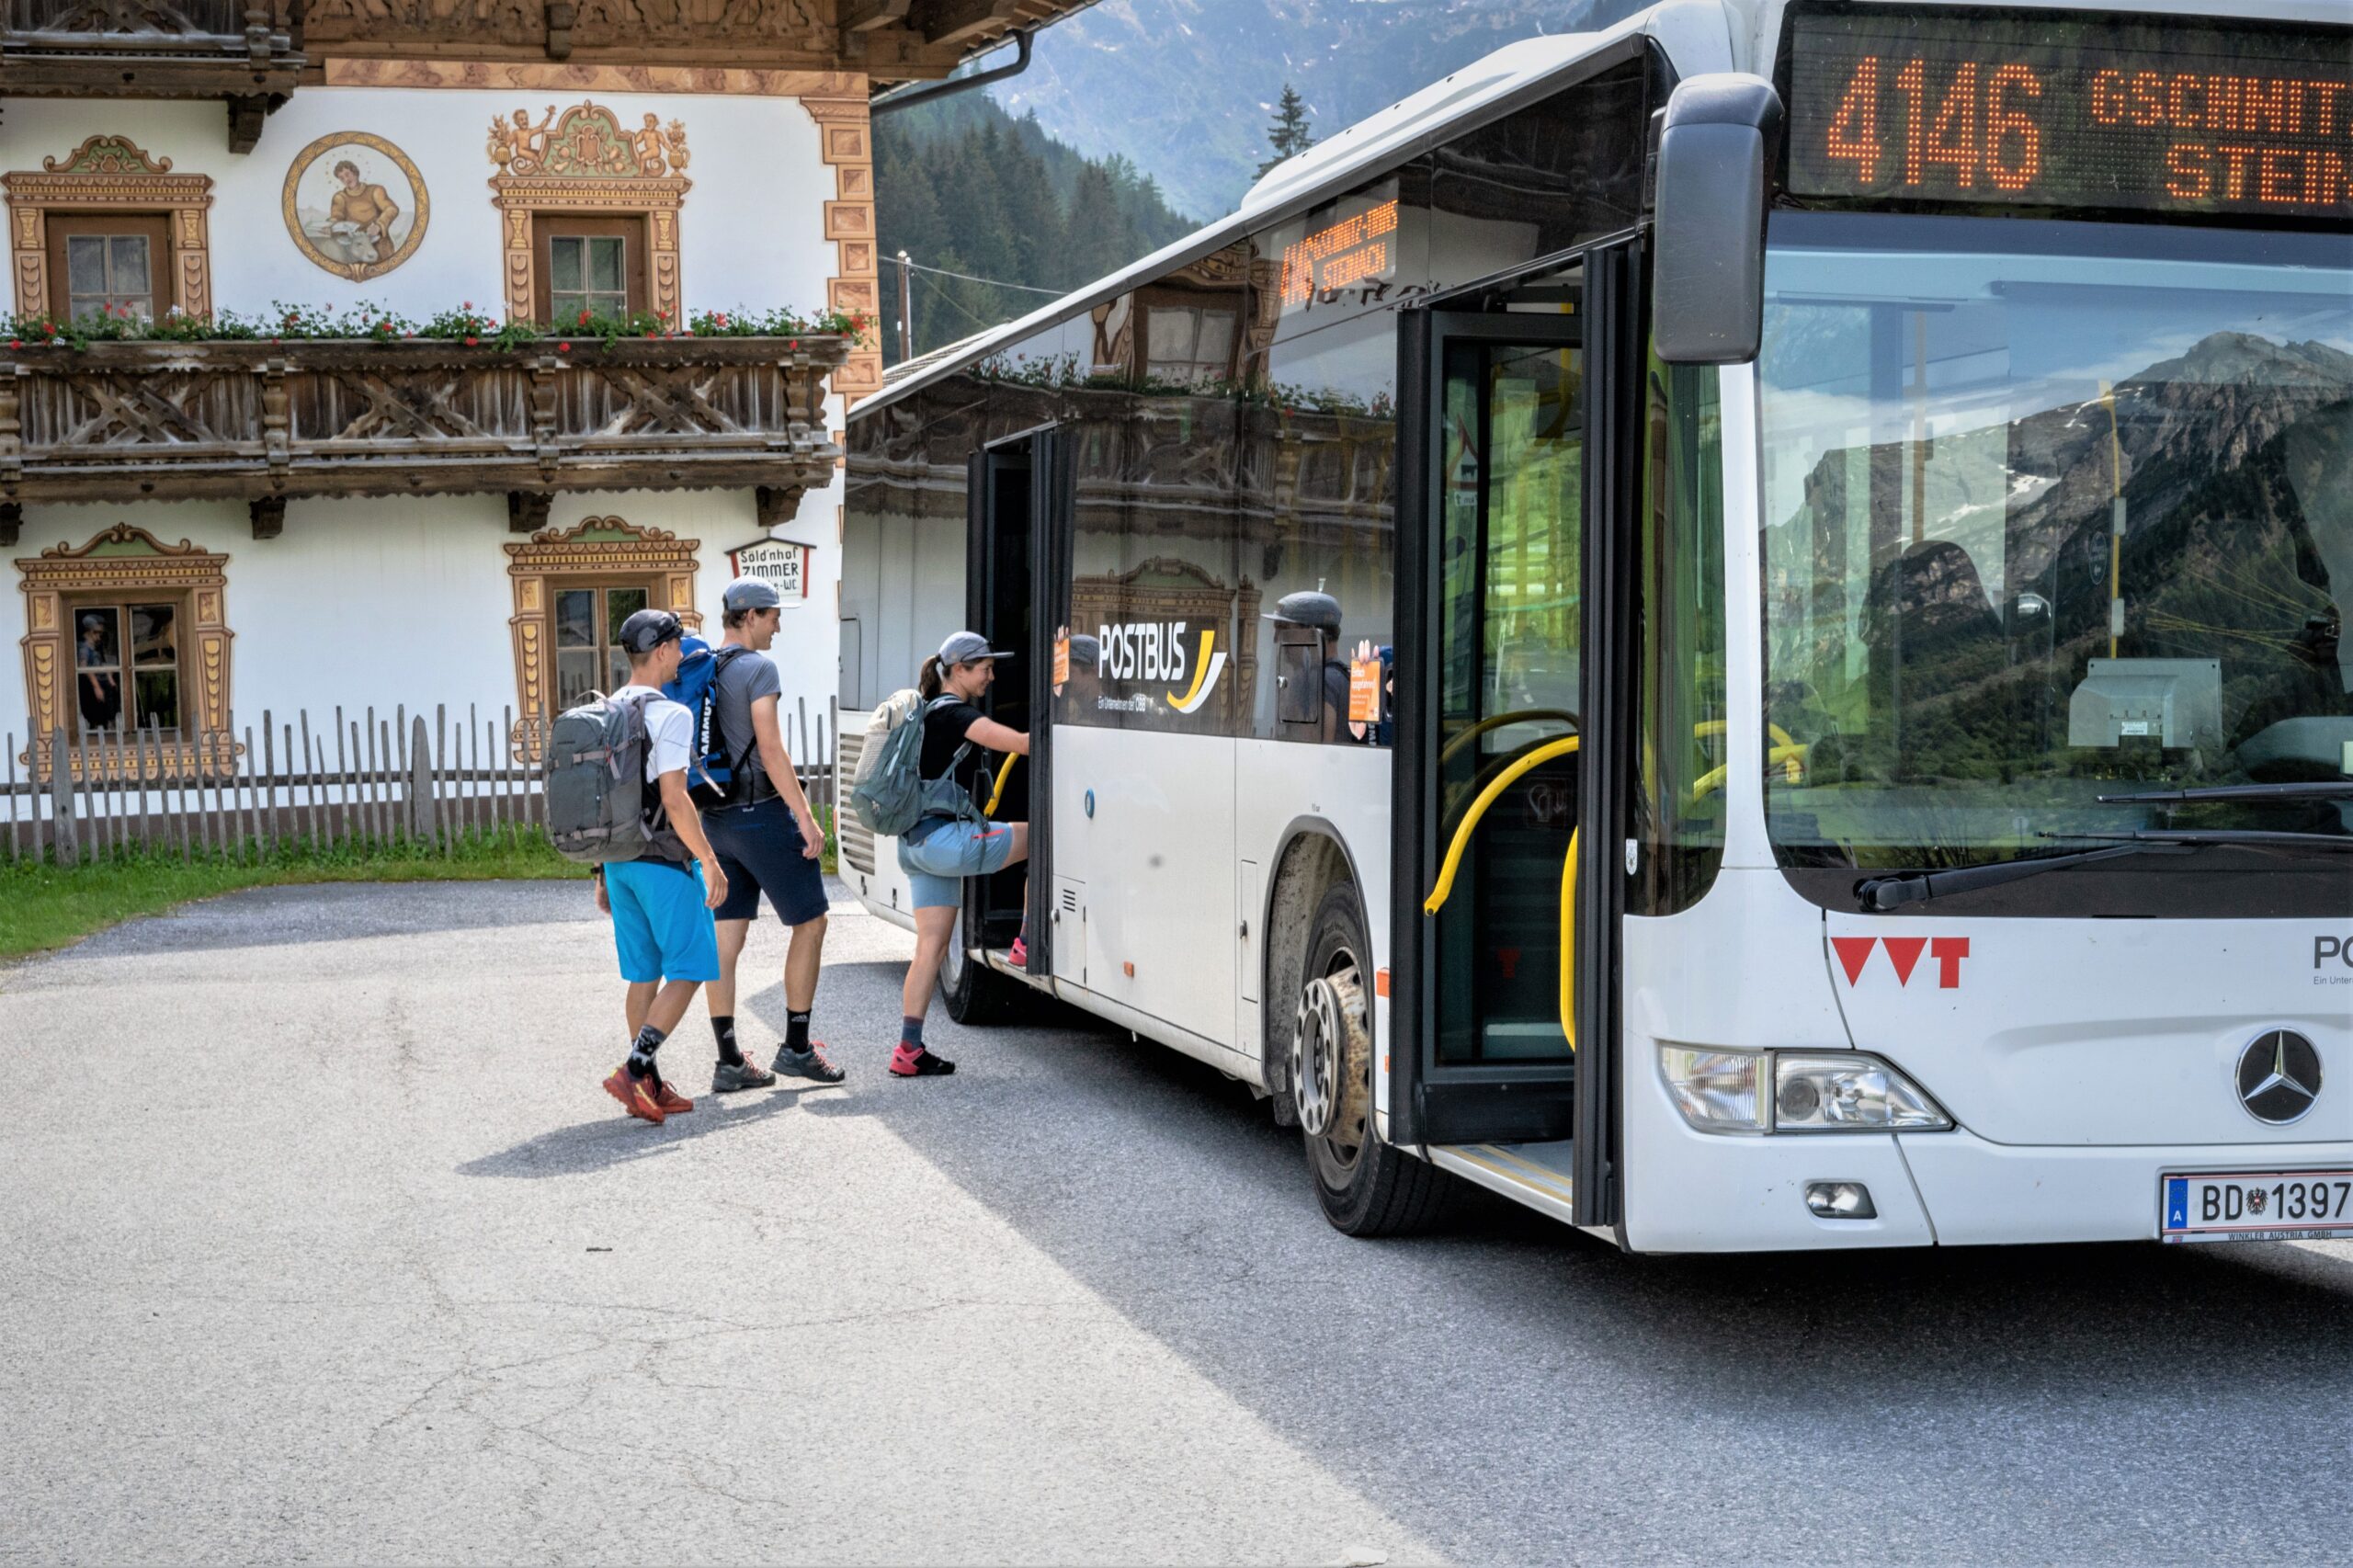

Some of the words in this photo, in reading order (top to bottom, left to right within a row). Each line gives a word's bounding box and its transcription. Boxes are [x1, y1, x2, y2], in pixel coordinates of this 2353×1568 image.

[1827, 56, 2040, 189] 4146
[2092, 69, 2353, 135] GSCHNIT
[1324, 241, 1386, 292] STEINACH
[742, 562, 799, 578] ZIMMER
[1098, 621, 1187, 681] POSTBUS
[700, 697, 712, 759] AMMUT
[2313, 976, 2326, 984] Ein
[2329, 976, 2353, 984] Unter
[2173, 1210, 2182, 1221] A
[2202, 1185, 2243, 1221] BD
[2271, 1182, 2351, 1219] 1397
[2228, 1233, 2264, 1241] WINKLER
[2269, 1231, 2303, 1240] AUSTRIA
